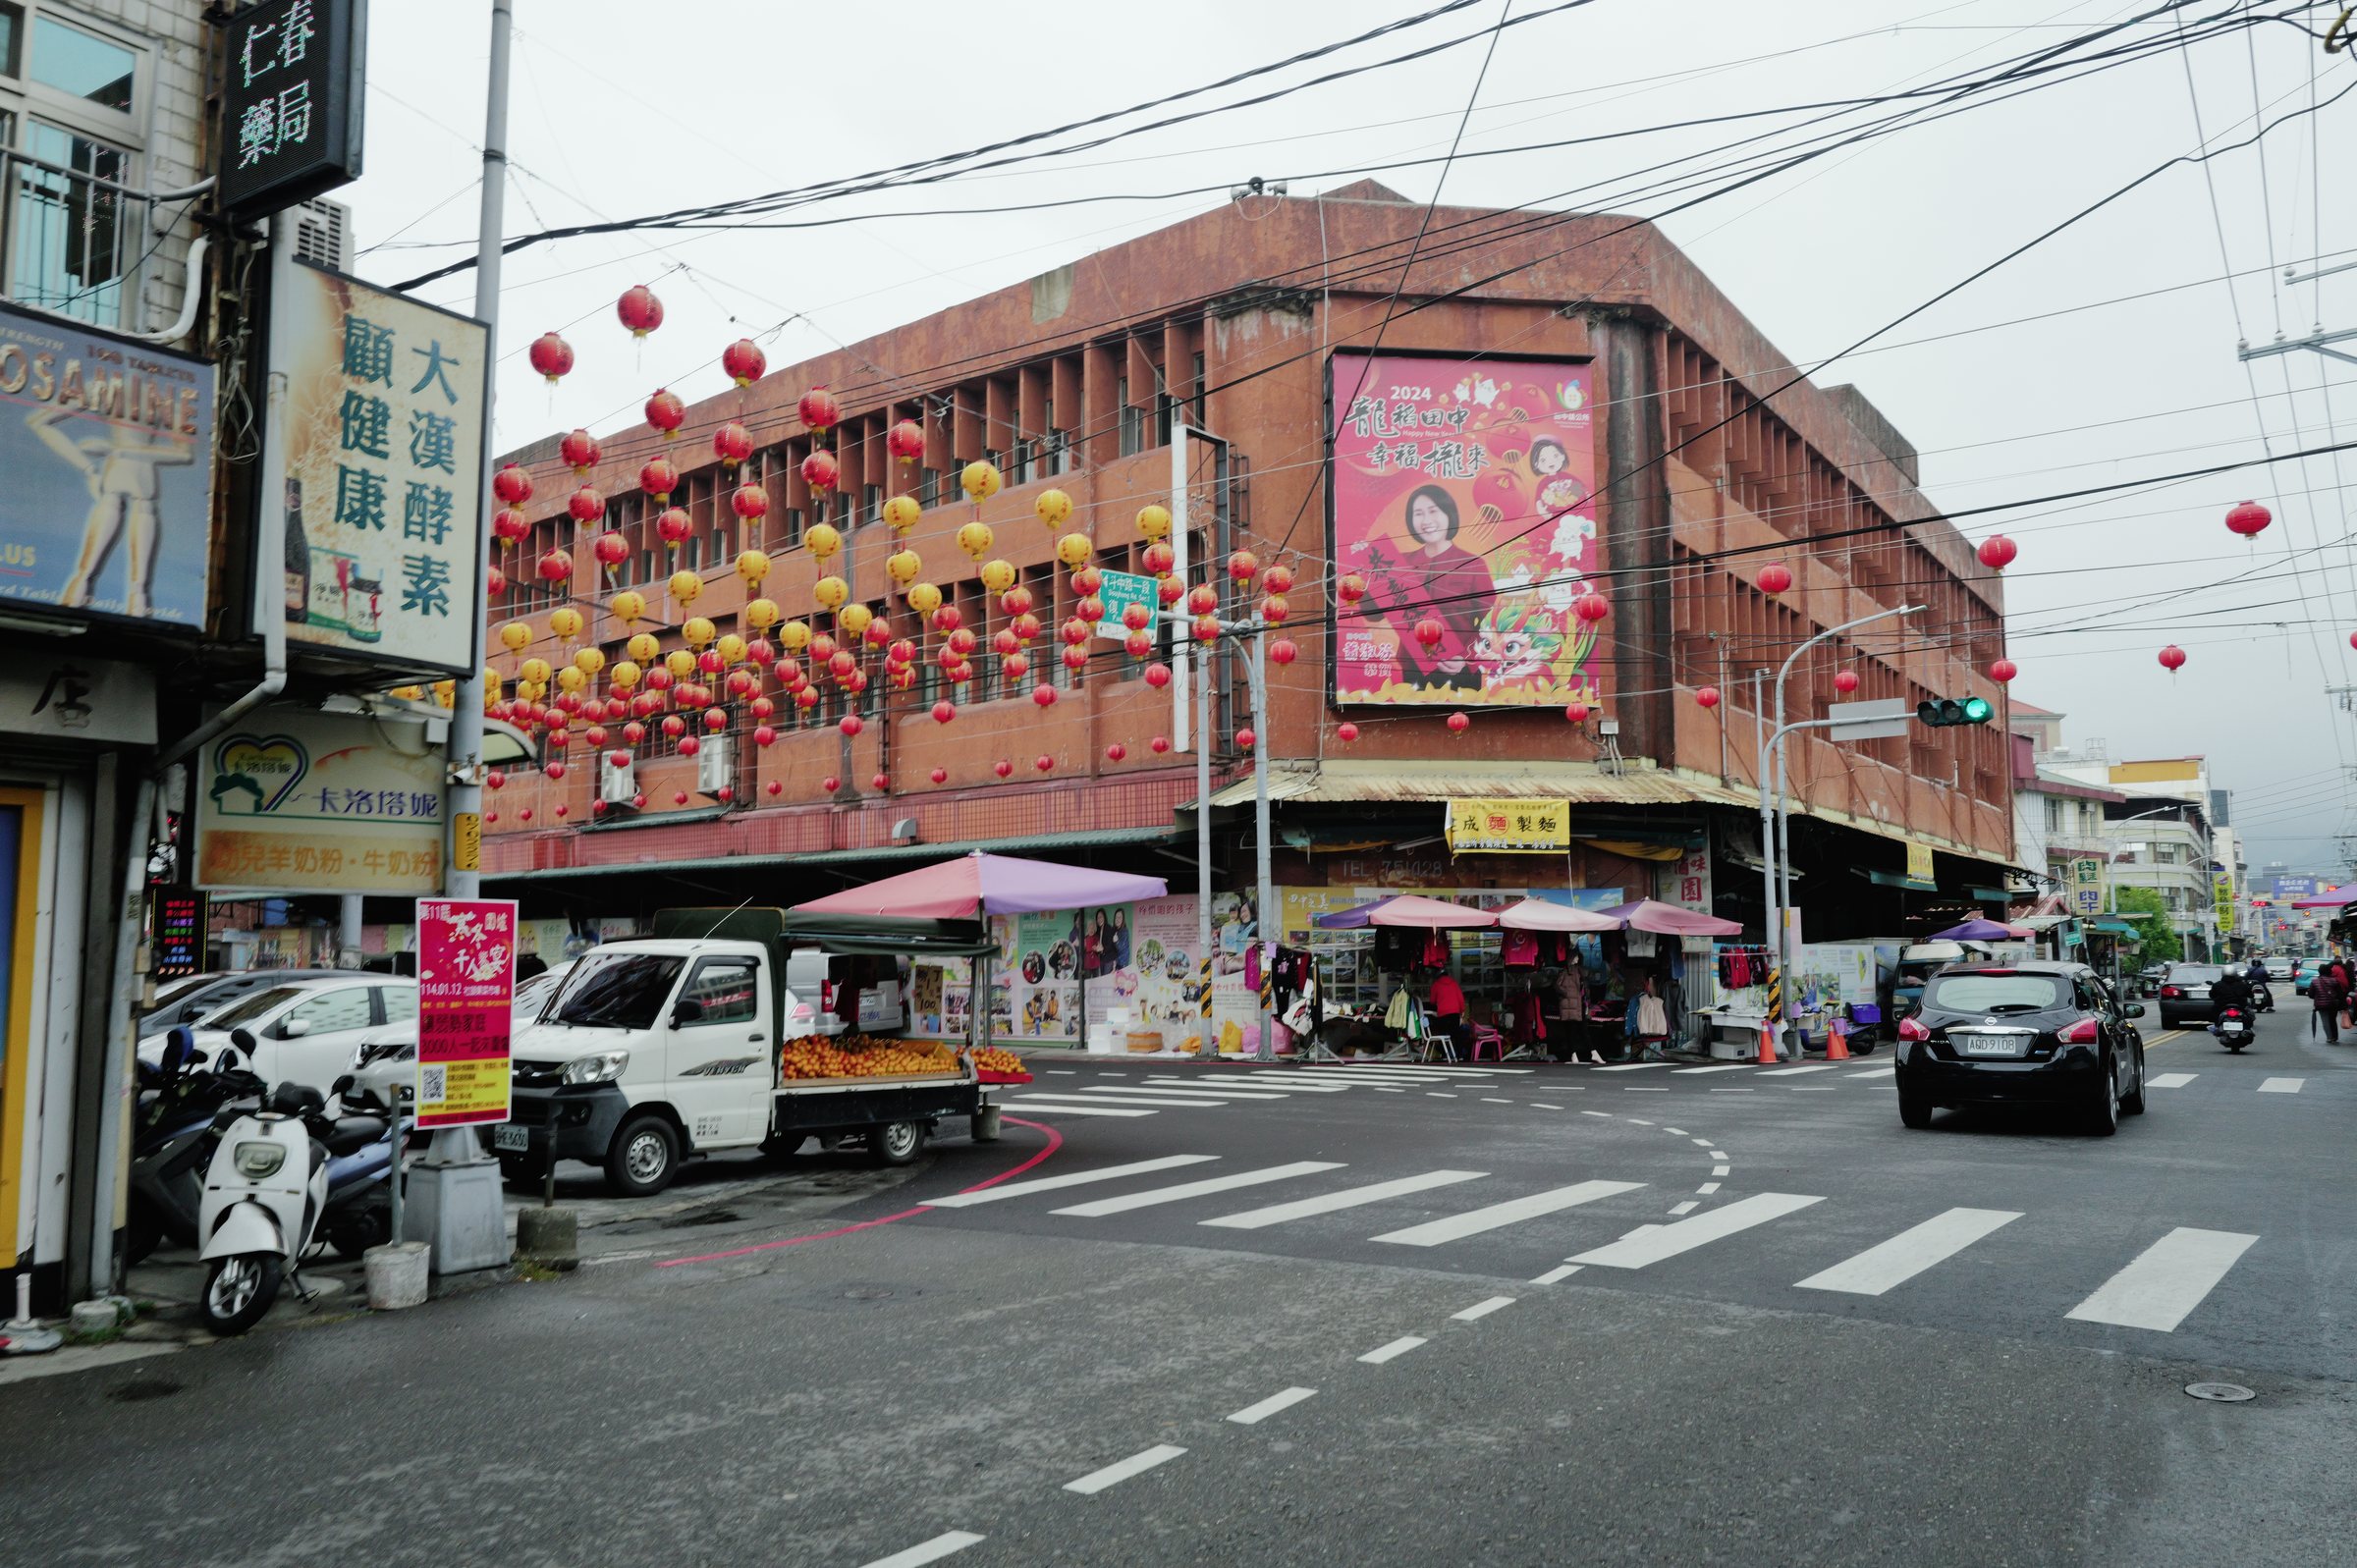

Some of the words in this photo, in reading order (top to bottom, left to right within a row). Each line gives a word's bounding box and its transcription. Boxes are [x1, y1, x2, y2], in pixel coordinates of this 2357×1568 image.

[239, 0, 315, 87] 仁春
[238, 80, 312, 169] 藥局
[1343, 395, 1470, 438] 龍稻田中
[1390, 386, 1432, 401] 2024
[334, 314, 396, 531] 顧健康
[1402, 429, 1424, 438] Happy
[400, 340, 461, 618] 大漢酵素
[1366, 440, 1490, 479] 幸福攏來
[30, 662, 93, 729] 店
[312, 787, 439, 817] 卡洛塔妮
